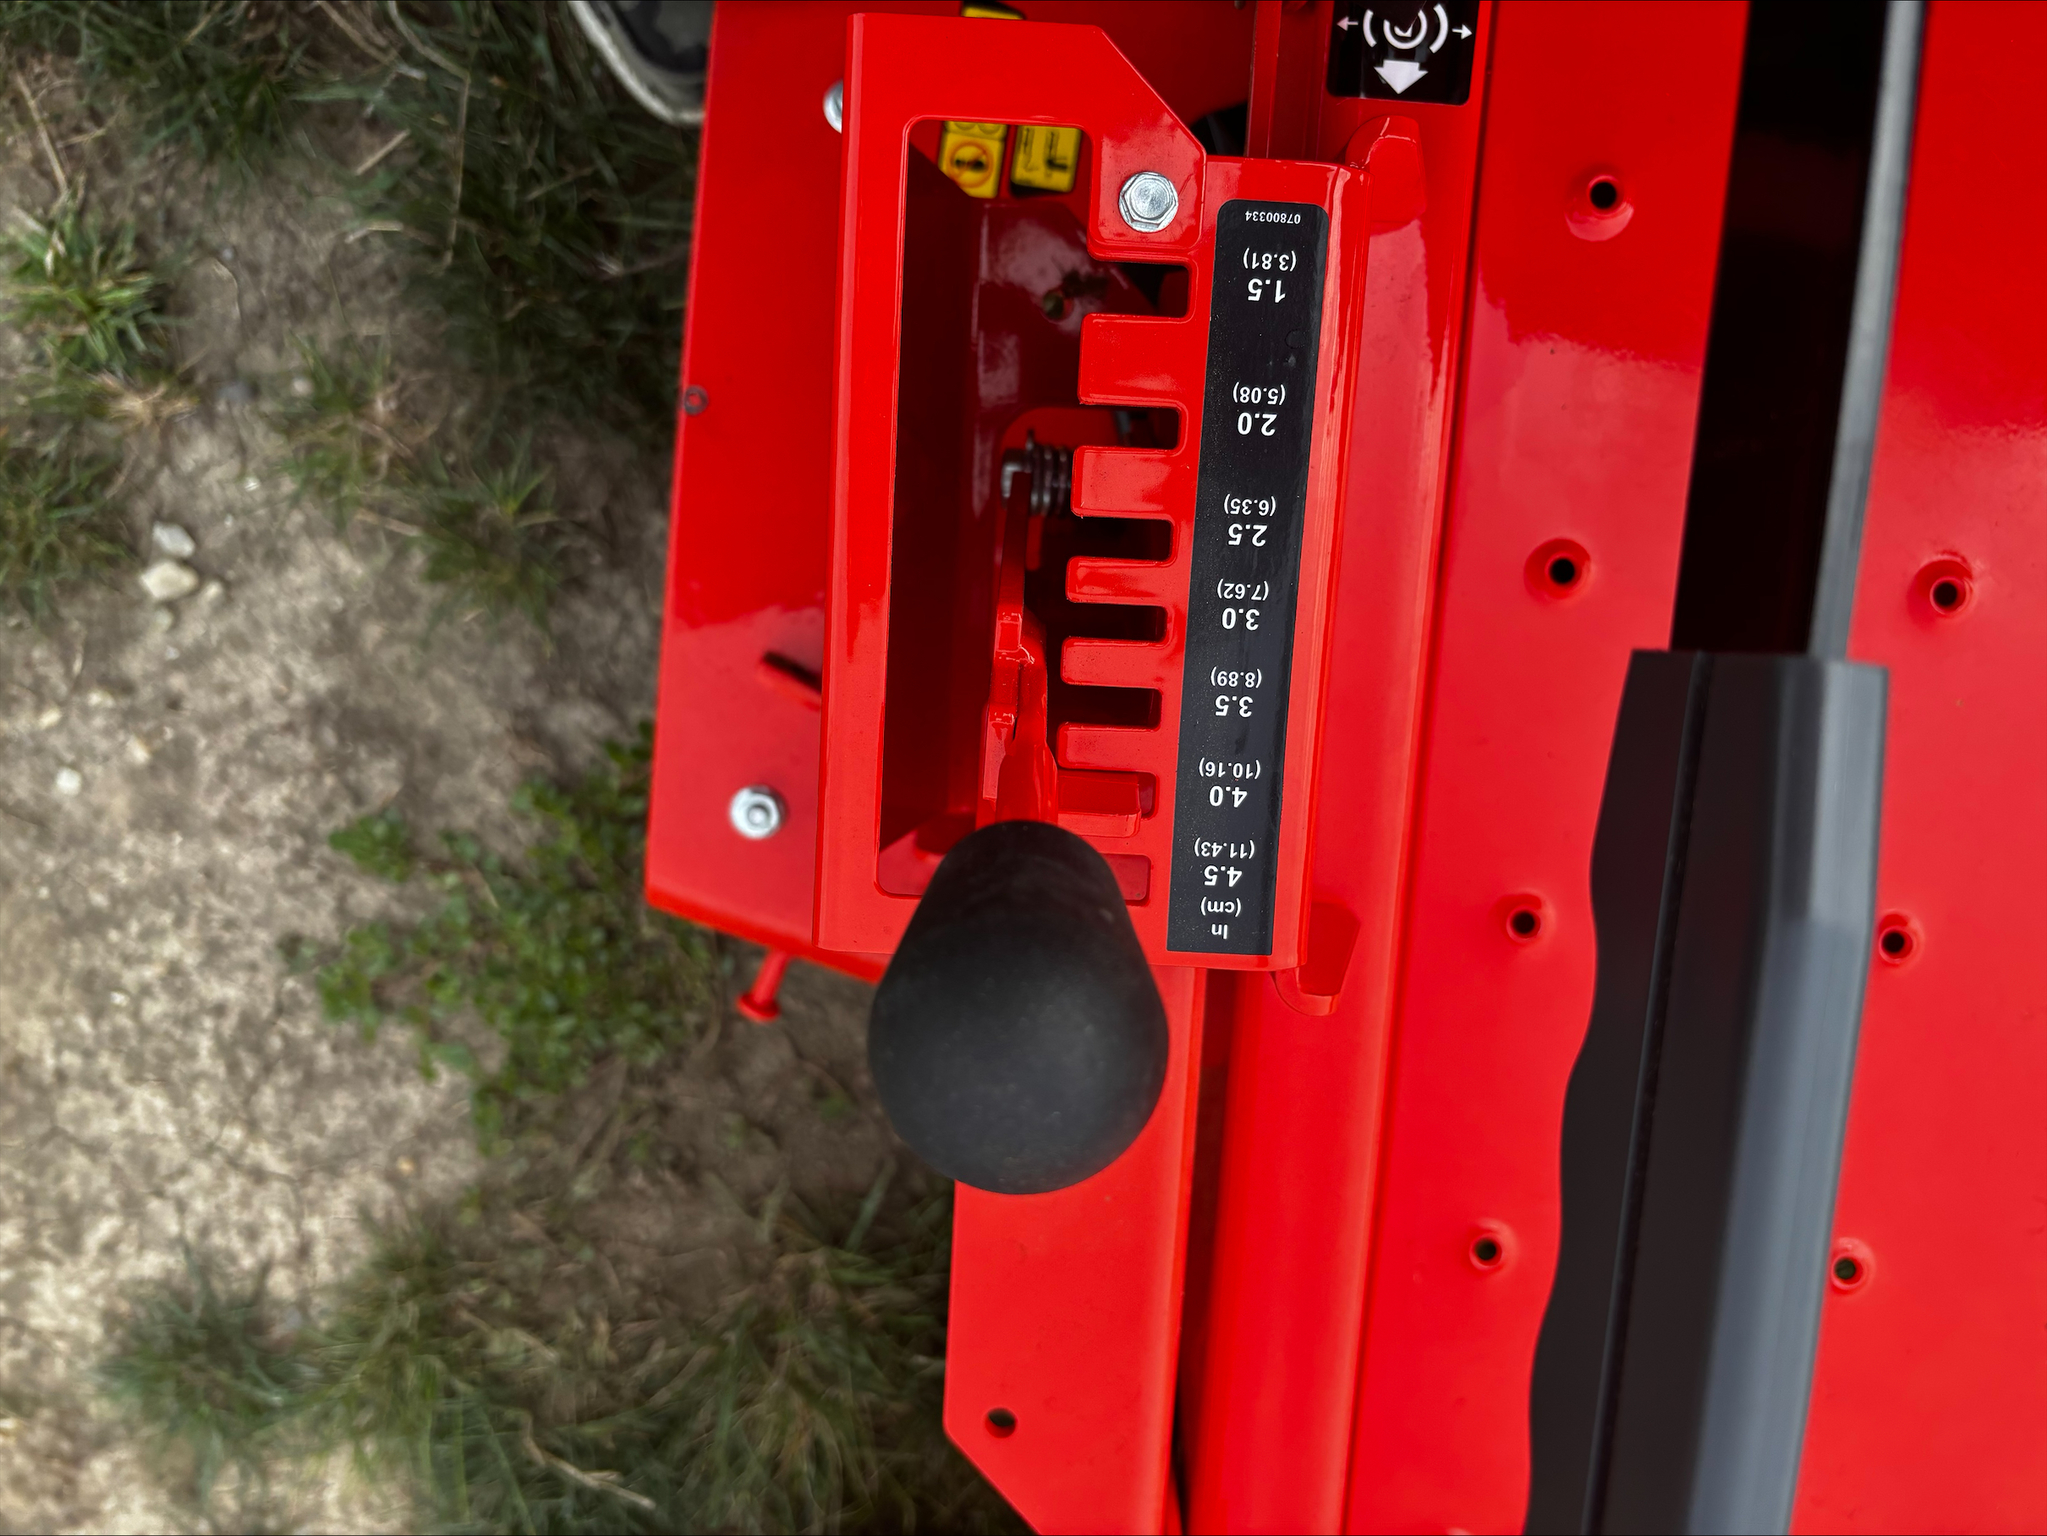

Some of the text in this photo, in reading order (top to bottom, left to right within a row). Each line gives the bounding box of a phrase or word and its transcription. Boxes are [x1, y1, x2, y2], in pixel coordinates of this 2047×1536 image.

[1245, 210, 1301, 225] 07800334
[1243, 247, 1297, 272] (3.81)
[1247, 278, 1286, 303] 1.5
[1232, 381, 1286, 406] (5.08)
[1237, 412, 1276, 437] 2.0
[1223, 493, 1277, 517] (6.35)
[1227, 523, 1268, 547] 2.5
[1216, 578, 1270, 601] (7.62)
[1221, 607, 1260, 631] 3.0
[1210, 666, 1263, 689] (8.89)
[1215, 694, 1254, 718] 3.5
[1198, 757, 1262, 780] (10.16)
[1209, 785, 1248, 808] 4.0
[1192, 837, 1255, 860] (11.43)
[1203, 865, 1243, 888] 4.5
[1200, 896, 1242, 918] (cm)
